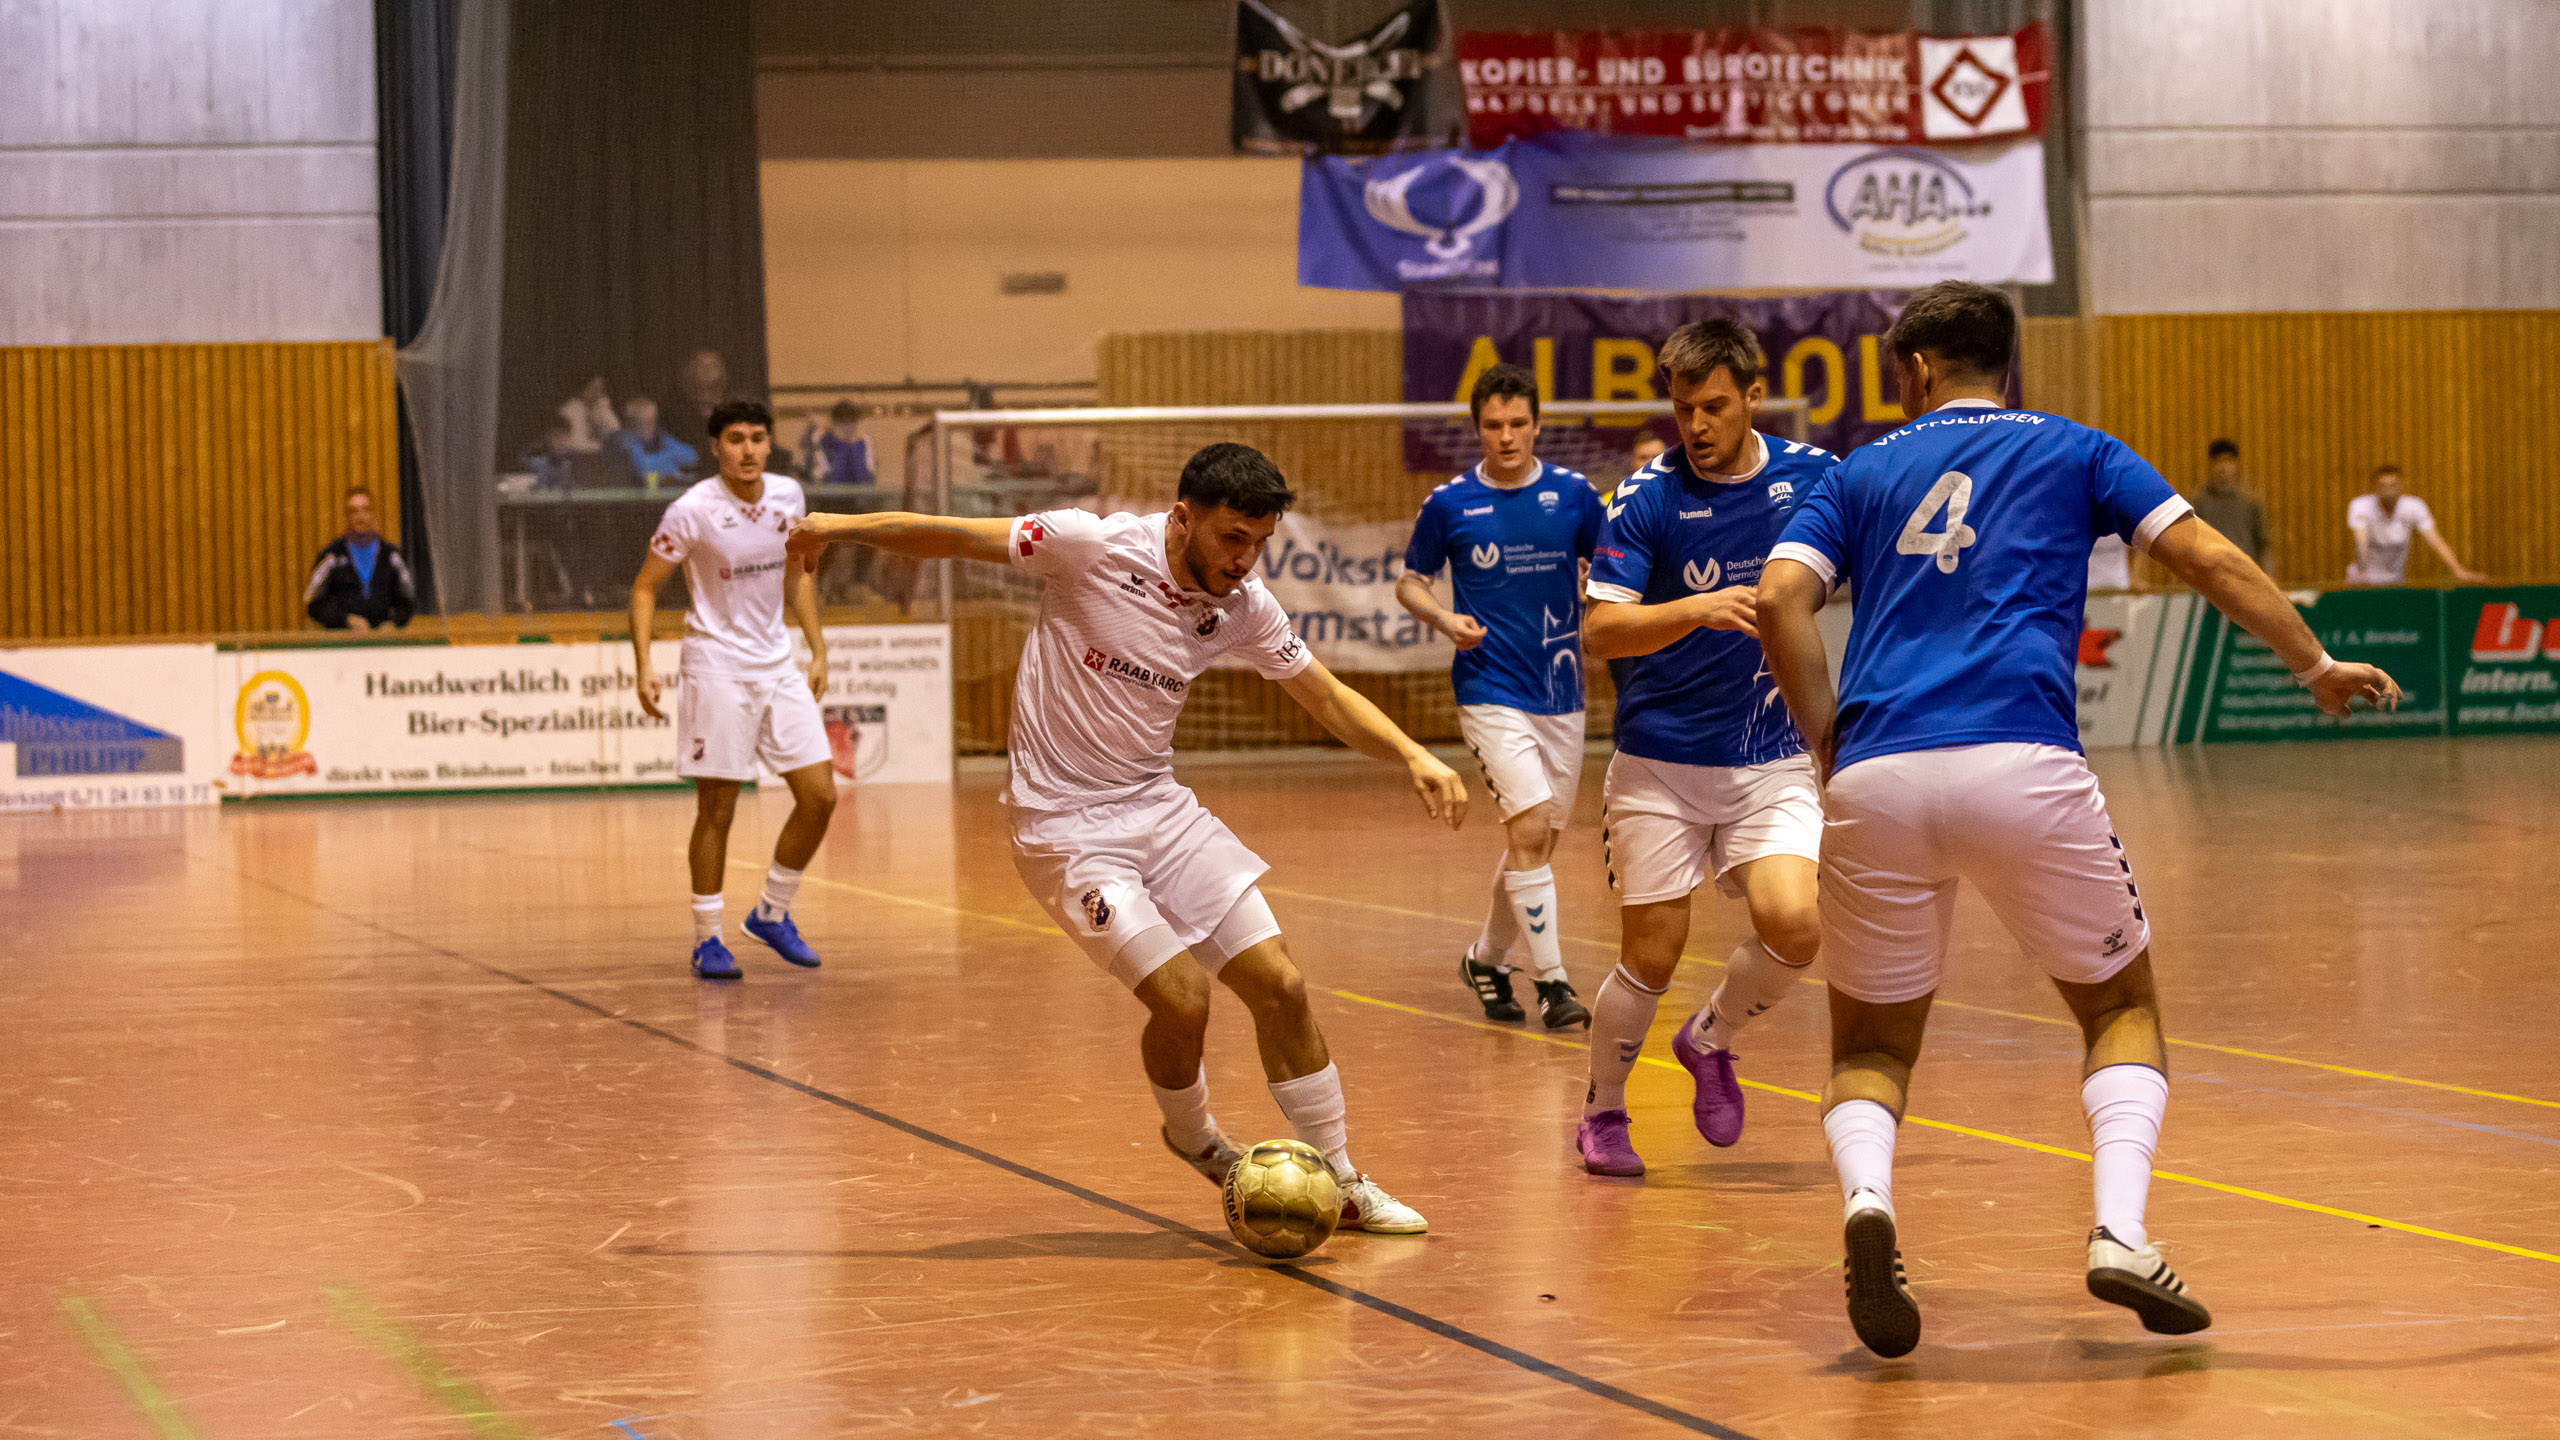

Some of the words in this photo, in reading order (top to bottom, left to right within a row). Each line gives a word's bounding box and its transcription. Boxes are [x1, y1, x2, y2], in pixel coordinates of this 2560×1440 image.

[1597, 56, 1666, 84] UND
[1872, 428, 1912, 447] VFL
[1679, 506, 1713, 520] hummel
[1896, 470, 1977, 575] 4
[1120, 582, 1147, 599] erima
[365, 669, 570, 698] Handwerklich
[1108, 657, 1151, 682] RAAB
[1152, 671, 1185, 693] KARC
[408, 707, 671, 738] Bier-Spezialitäten
[2102, 940, 2128, 959] hummel
